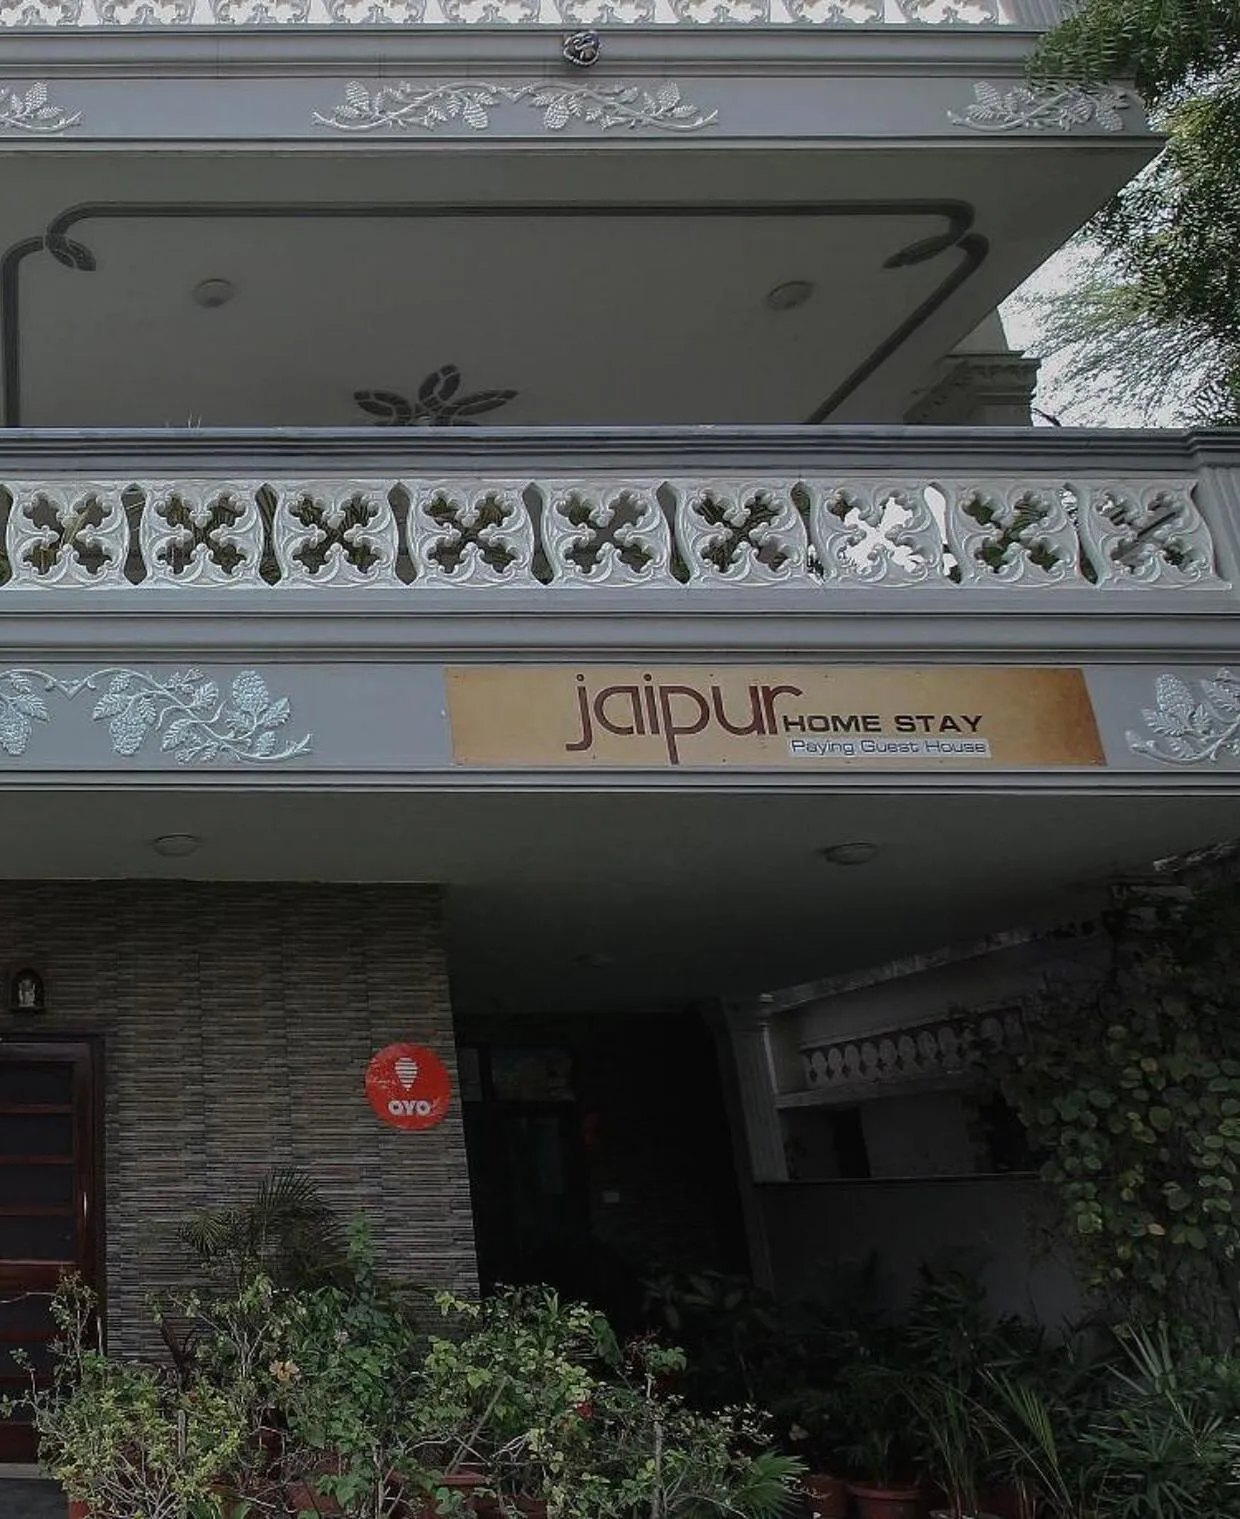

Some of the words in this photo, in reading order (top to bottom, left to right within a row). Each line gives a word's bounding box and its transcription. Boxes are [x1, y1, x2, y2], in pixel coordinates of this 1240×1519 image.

[565, 673, 803, 764] jaipur
[783, 715, 882, 733] HOME
[895, 715, 983, 733] STAY
[791, 739, 856, 757] Paying
[862, 739, 920, 755] Guest
[927, 740, 986, 755] House
[388, 1100, 431, 1116] OYO
